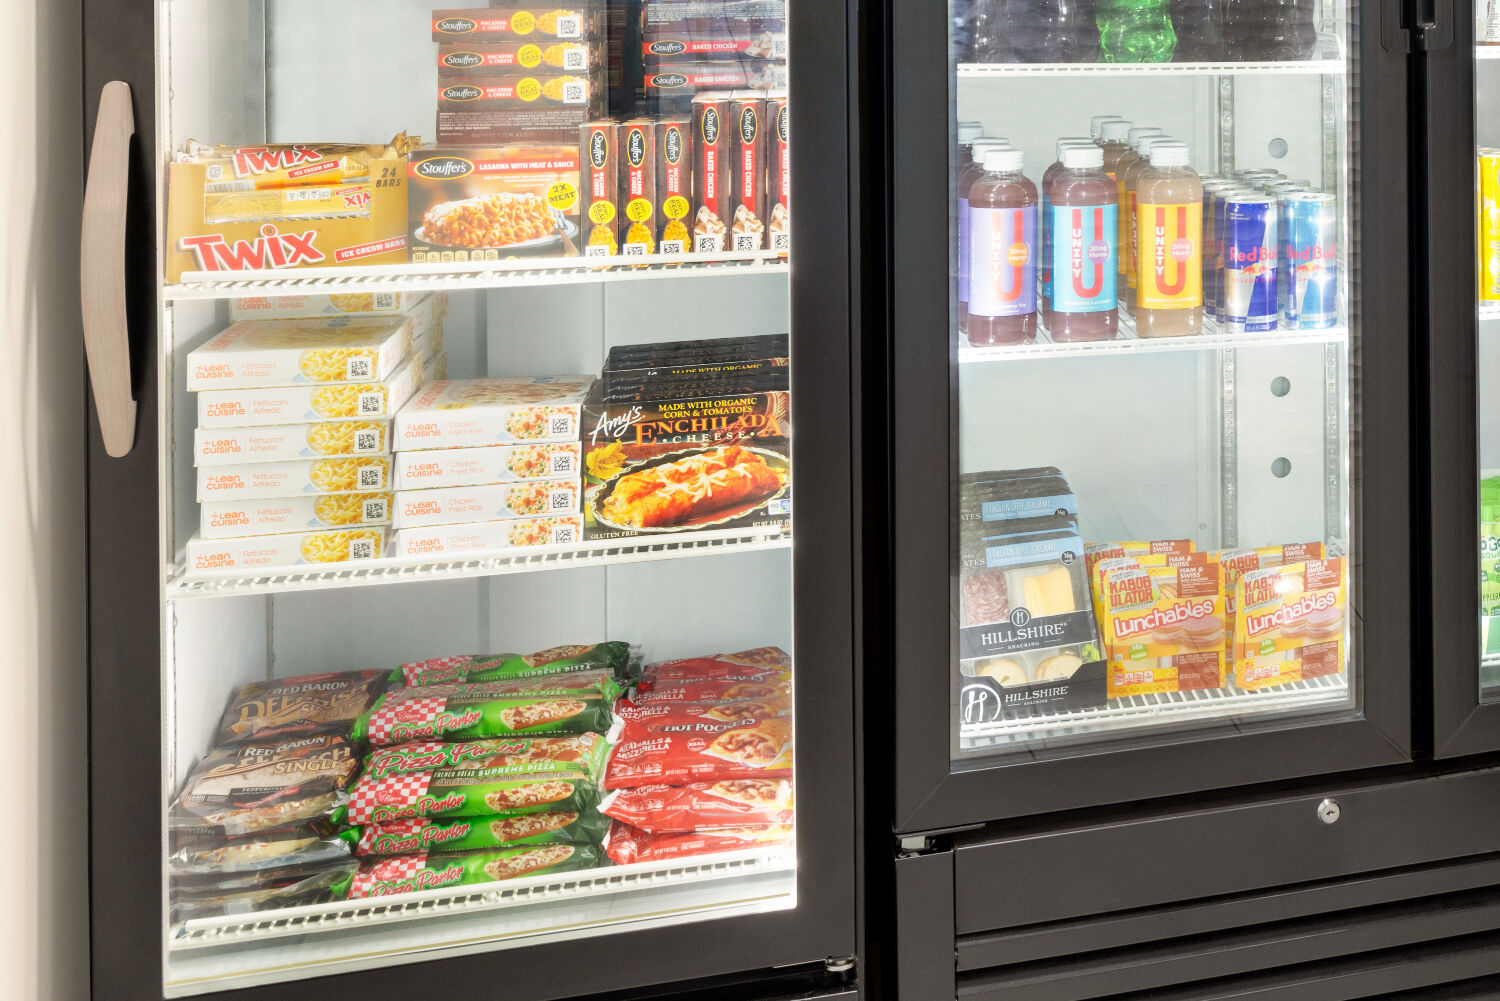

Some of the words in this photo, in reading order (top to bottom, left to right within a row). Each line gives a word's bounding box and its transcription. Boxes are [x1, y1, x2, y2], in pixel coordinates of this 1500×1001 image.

[380, 167, 397, 179] 24
[420, 157, 474, 176] Stouffer's
[375, 178, 402, 188] BARS
[549, 191, 577, 202] MEAT
[1071, 228, 1082, 279] UNITY
[1229, 246, 1256, 263] Red
[658, 403, 686, 413] MADE
[687, 401, 712, 410] WITH
[714, 398, 758, 408] ORGANIC
[663, 410, 692, 419] CORN
[693, 408, 700, 417] &
[701, 406, 753, 417] TOMATOES
[589, 406, 643, 446] Amy's
[631, 413, 785, 448] ENCHILADA
[672, 430, 746, 444] CHEESE
[1109, 575, 1152, 594] KABOB
[1109, 588, 1154, 608] ULATOR
[1114, 598, 1216, 640] Lunchables
[1246, 590, 1337, 636] Lunchables
[981, 623, 1065, 646] HILLSHIRE
[519, 666, 564, 679] SUPREME
[564, 663, 592, 674] PIZZA
[272, 684, 301, 696] RED
[302, 680, 349, 694] BARON
[1004, 686, 1069, 702] HILLSHIRE
[392, 724, 435, 739] Pizza
[434, 709, 482, 734] Parlor
[373, 807, 416, 823] Pizza
[417, 793, 465, 816] Parlor
[417, 864, 465, 888] Parlor
